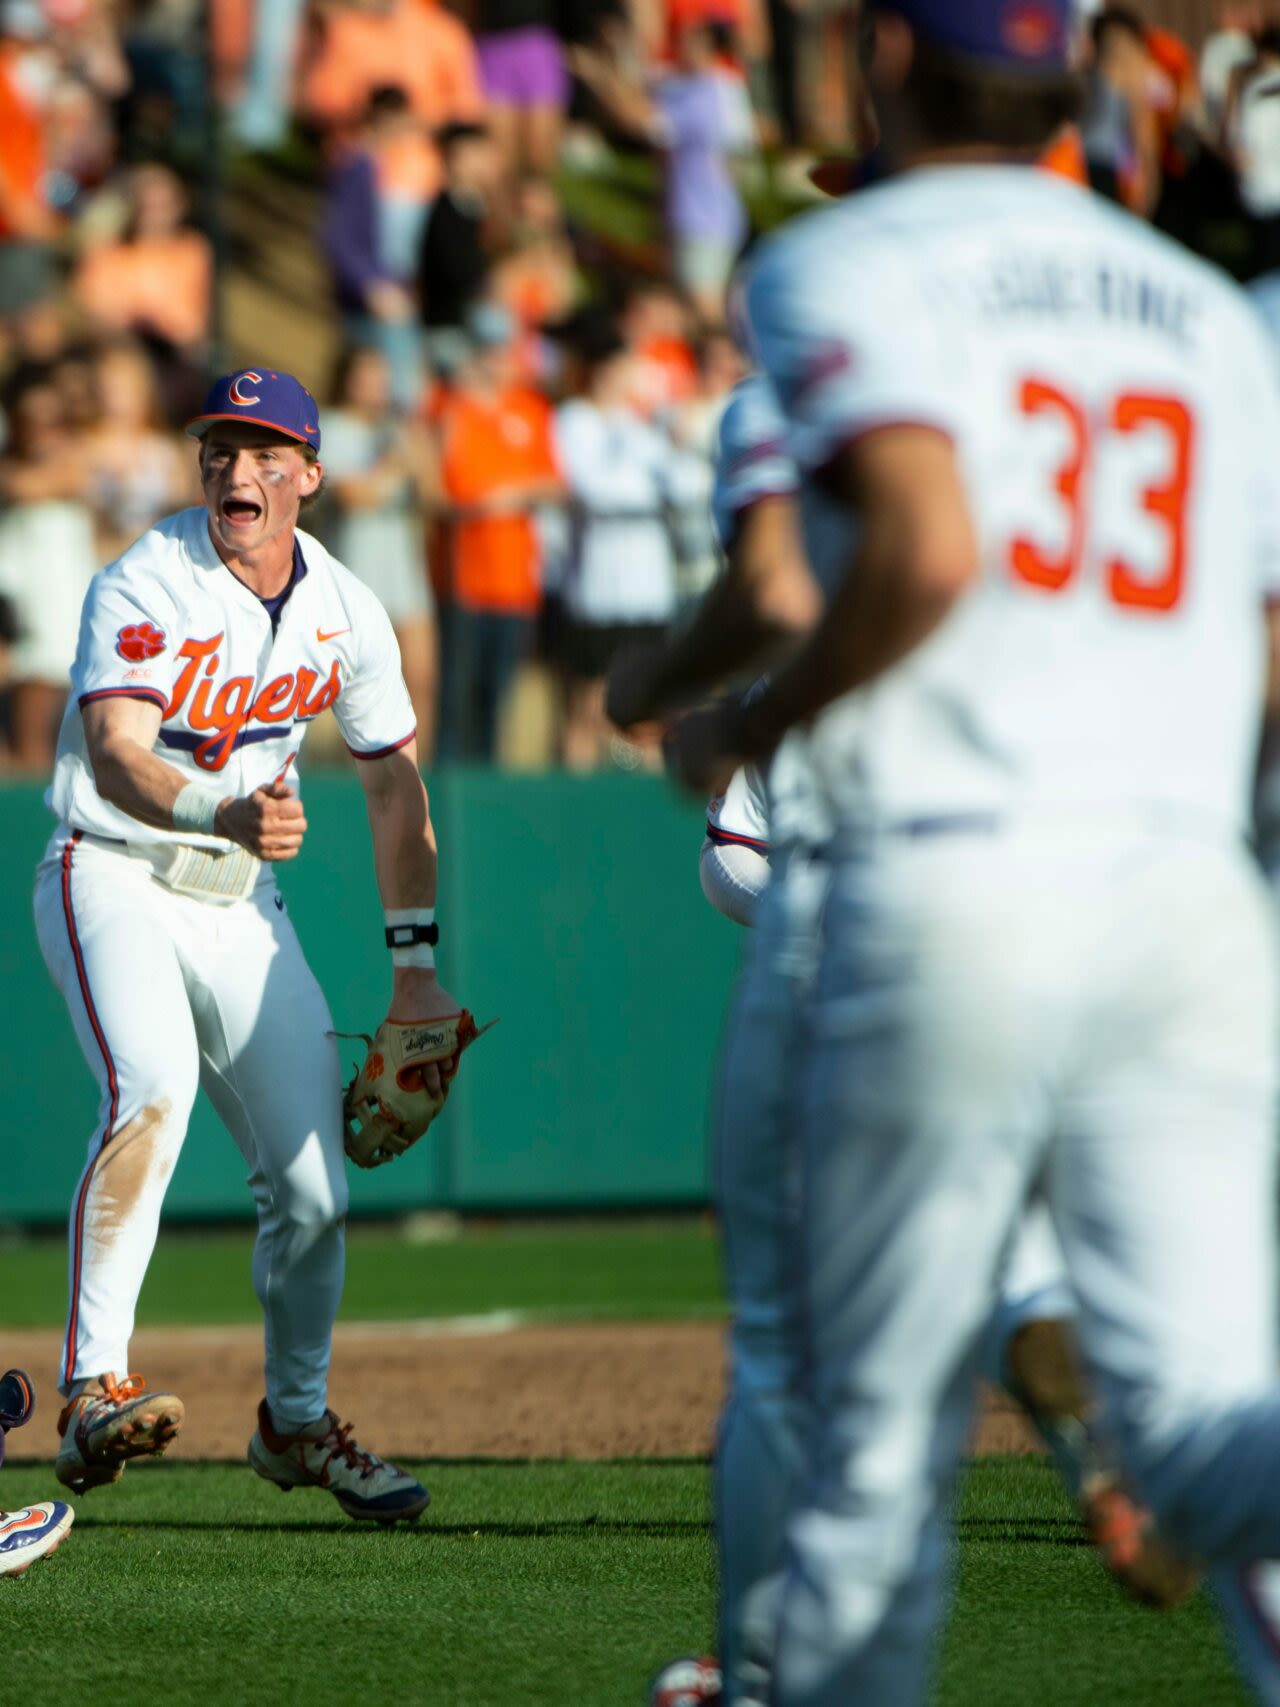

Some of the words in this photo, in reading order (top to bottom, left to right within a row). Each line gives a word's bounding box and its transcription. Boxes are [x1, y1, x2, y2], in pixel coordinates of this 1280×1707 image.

[228, 371, 262, 406] C
[1008, 373, 1194, 615] 33
[162, 631, 341, 772] Tigers
